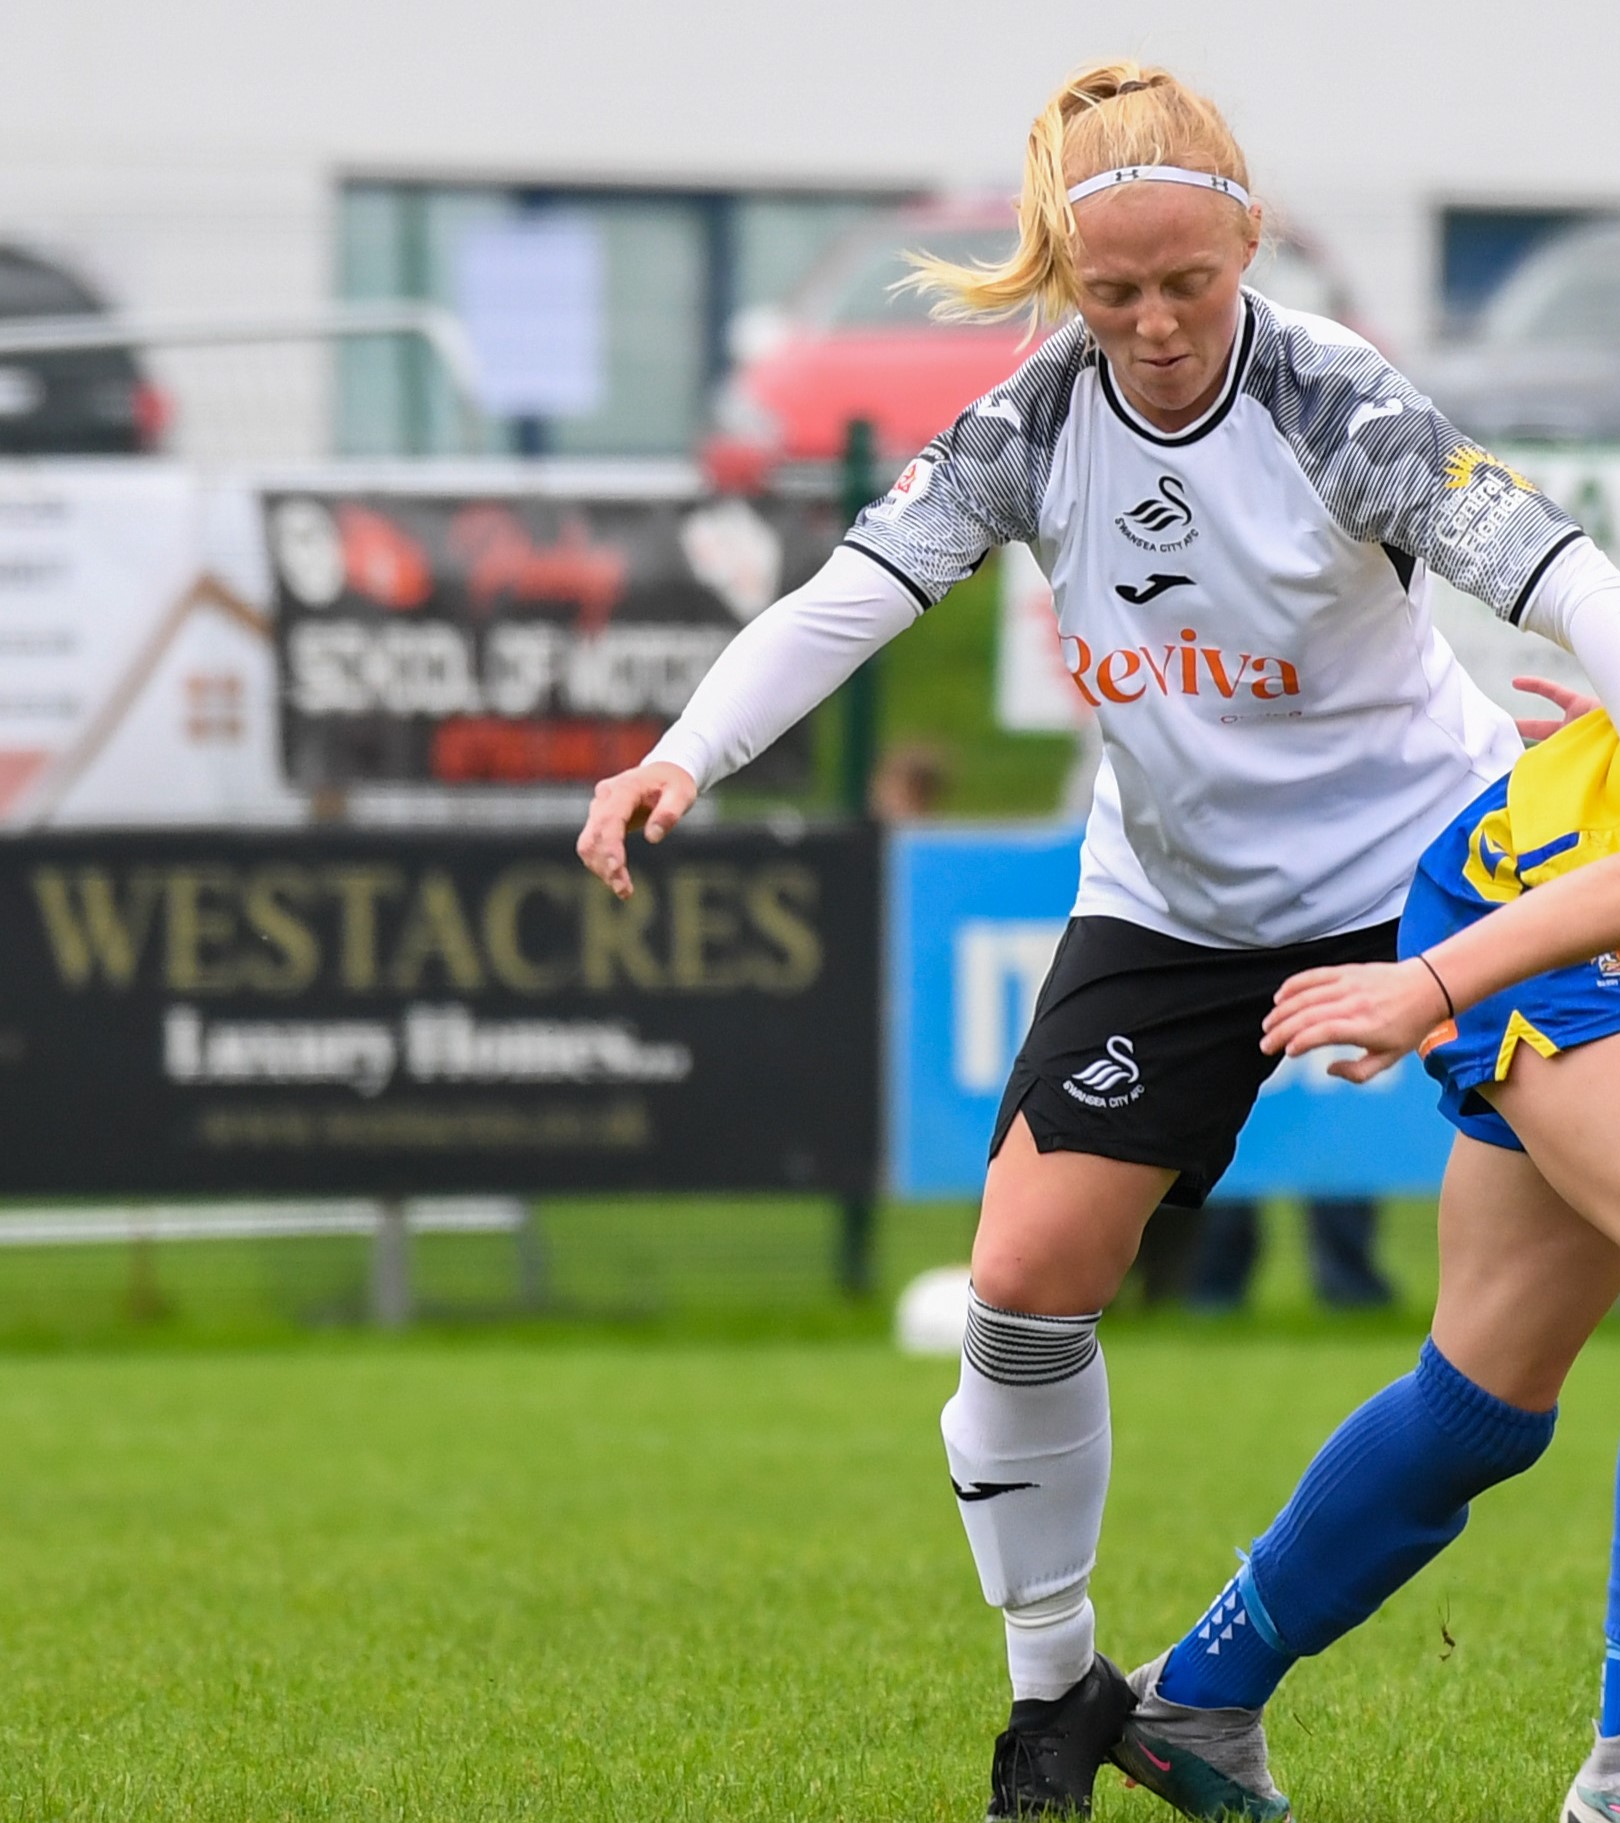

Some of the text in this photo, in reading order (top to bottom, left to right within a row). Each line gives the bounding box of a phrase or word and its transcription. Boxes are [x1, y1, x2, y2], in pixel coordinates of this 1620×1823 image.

[1115, 517, 1200, 553] SWANSEA CITY AFC
[1435, 472, 1505, 545] Central
[1459, 488, 1529, 552] Florida
[1057, 628, 1301, 707] Reviva
[32, 862, 825, 994] WESTACRES
[162, 1004, 395, 1098] Luxury
[1063, 1080, 1145, 1108] SWANSEA CITY AFC
